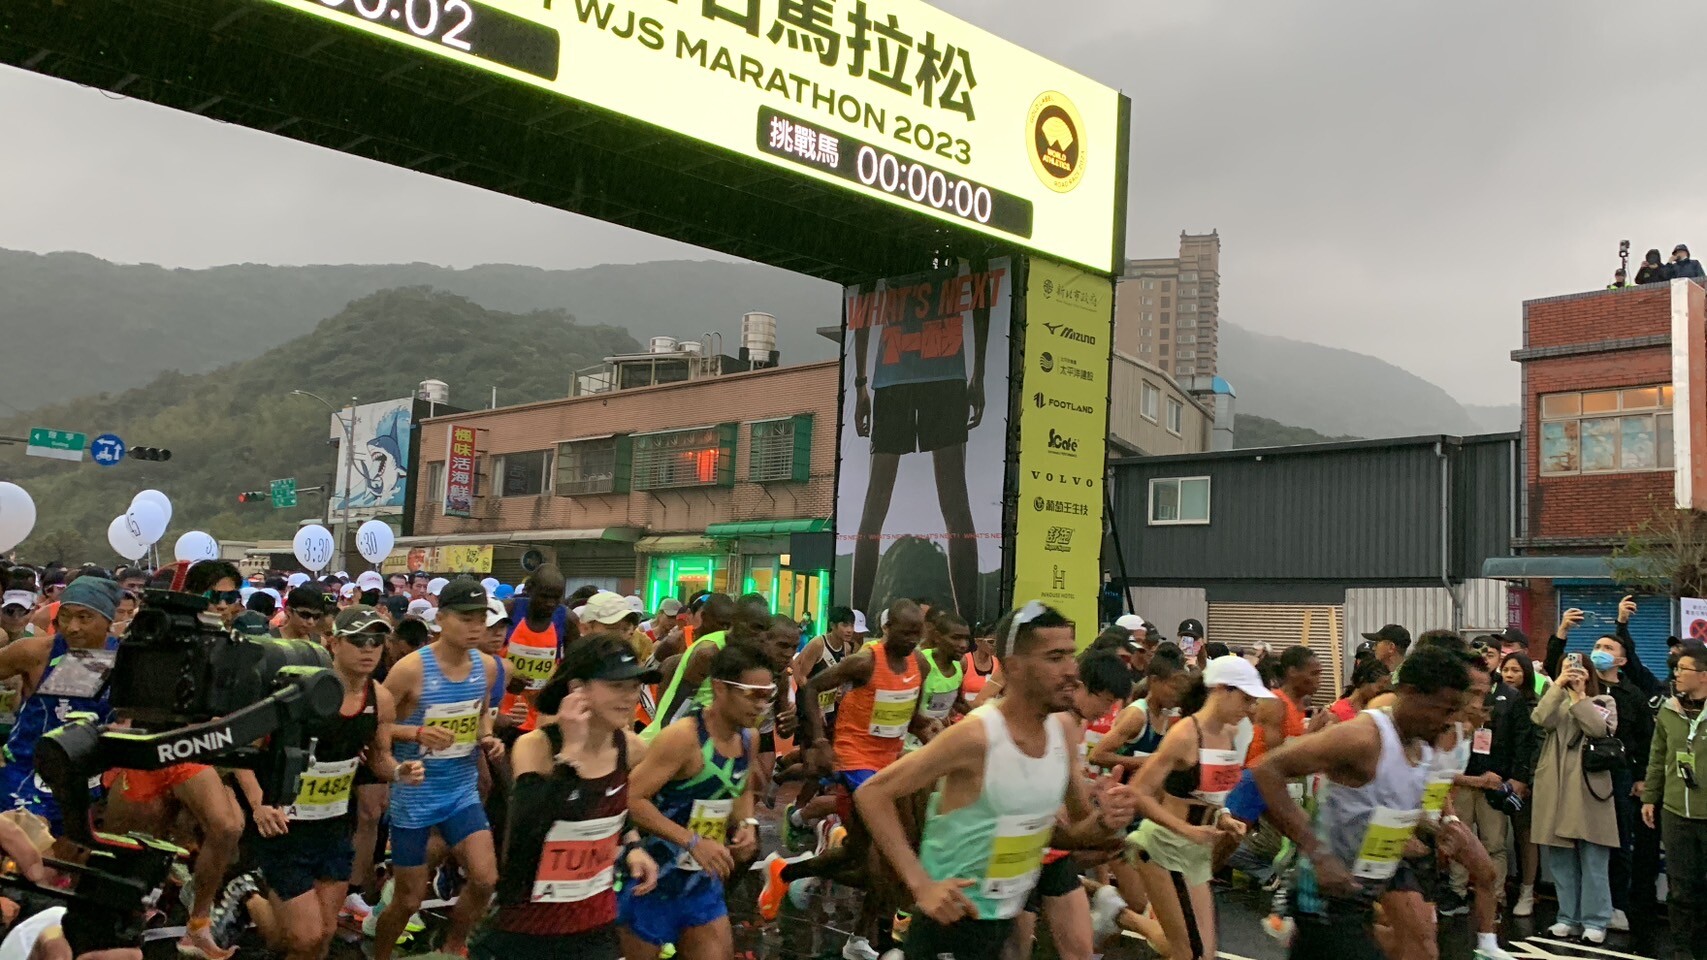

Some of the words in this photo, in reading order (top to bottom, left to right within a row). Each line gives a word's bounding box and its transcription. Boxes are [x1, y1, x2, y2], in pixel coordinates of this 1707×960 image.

[575, 0, 665, 50] WJS
[675, 29, 886, 134] MARATHON
[893, 115, 971, 164] 2023
[769, 116, 840, 168] 挑戰馬
[1047, 147, 1067, 161] WORLD
[857, 145, 992, 224] 00:00:00
[848, 282, 932, 331] WHAT'S
[938, 267, 1006, 316] NEXT
[1049, 398, 1094, 414] FOOTLAND
[1031, 470, 1094, 488] VOLVO
[1046, 499, 1089, 516] 葡萄王生技
[304, 537, 330, 563] 3:30
[157, 726, 233, 763] RONIN
